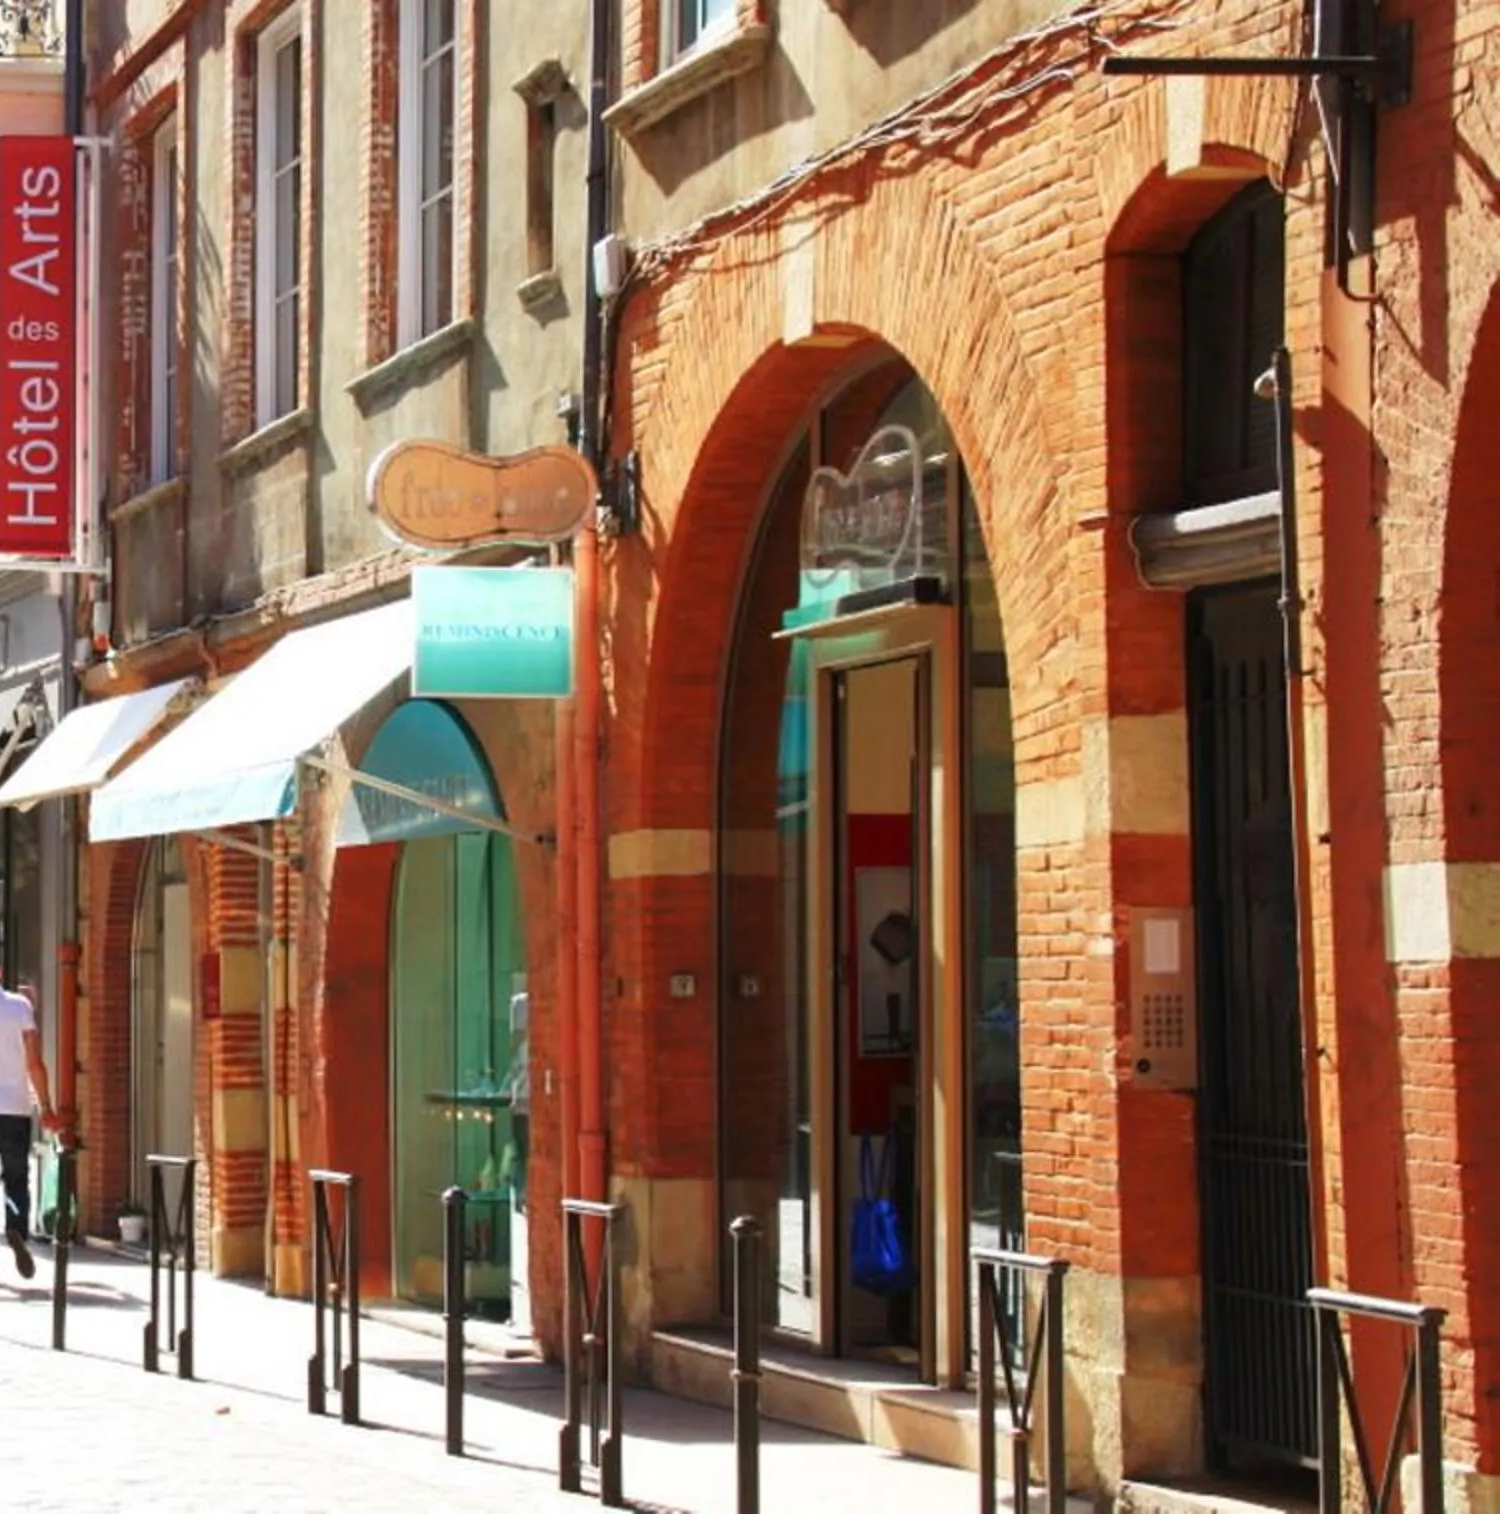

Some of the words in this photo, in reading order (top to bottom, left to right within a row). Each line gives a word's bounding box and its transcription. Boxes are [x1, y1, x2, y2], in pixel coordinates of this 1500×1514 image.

[7, 165, 60, 296] Arts
[7, 315, 59, 341] des
[7, 361, 59, 525] Hôtel
